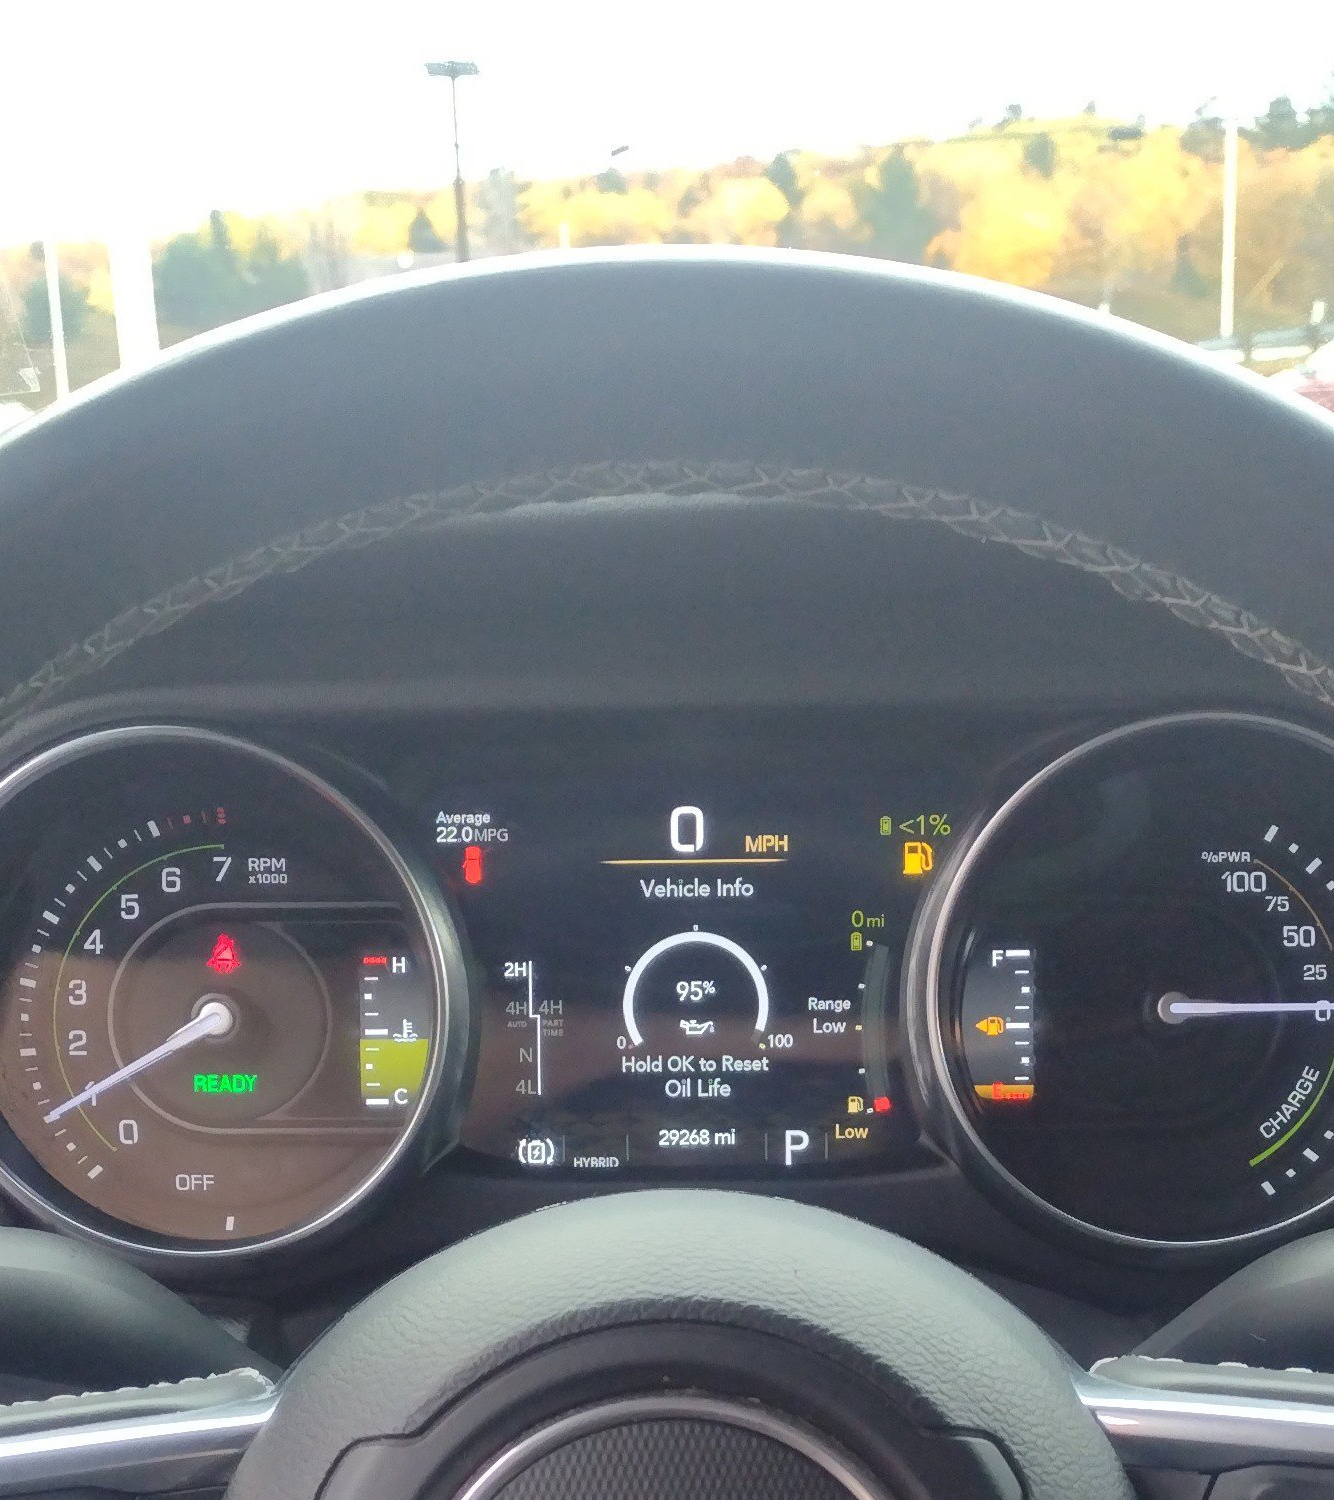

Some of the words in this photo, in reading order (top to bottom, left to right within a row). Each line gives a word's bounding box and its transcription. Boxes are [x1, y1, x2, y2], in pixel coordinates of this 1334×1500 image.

[435, 811, 492, 827] Average
[898, 815, 951, 838] <1%
[669, 805, 705, 853] 0
[745, 835, 789, 853] MPH
[247, 858, 287, 873] RPM
[1201, 851, 1251, 864] %PWR
[212, 857, 233, 883] 7
[247, 873, 288, 885] x1000
[161, 867, 182, 893] 6
[640, 879, 712, 899] Vehicle
[717, 879, 754, 898] Info
[1221, 870, 1267, 893] 100
[119, 894, 140, 920] 5
[1265, 895, 1290, 912] 75
[83, 929, 104, 956] 4
[1283, 925, 1316, 948] 50
[391, 956, 407, 974] H
[991, 949, 1005, 968] F
[503, 961, 527, 977] 2H
[1303, 964, 1328, 981] 25
[68, 979, 88, 1005] 3
[676, 981, 716, 1002] 95%
[505, 1001, 528, 1016] 4H
[538, 1000, 563, 1015] 4H
[808, 996, 852, 1013] Range
[1315, 1000, 1332, 1022] 0
[507, 1021, 528, 1029] AUTO
[542, 1019, 564, 1027] PART
[812, 1019, 847, 1033] Low
[542, 1028, 564, 1037] TIME
[767, 1034, 794, 1049] 100
[68, 1030, 88, 1057] 2
[616, 1036, 627, 1050] 0
[519, 1047, 533, 1063] N
[621, 1056, 663, 1073] Hold
[667, 1056, 696, 1073] OK
[699, 1058, 717, 1073] to
[722, 1056, 770, 1072] Reset
[192, 1073, 260, 1095] READY
[515, 1079, 537, 1095] 4L
[664, 1079, 691, 1098] Oil
[696, 1079, 732, 1098] Life
[394, 1088, 409, 1106] C
[1259, 1065, 1320, 1140] CHARGE
[118, 1119, 139, 1146] 0
[658, 1129, 710, 1146] 29268
[714, 1128, 736, 1145] mi
[834, 1125, 869, 1140] Low
[783, 1129, 810, 1166] P
[573, 1156, 620, 1169] HYBRID
[175, 1174, 215, 1193] OFF
